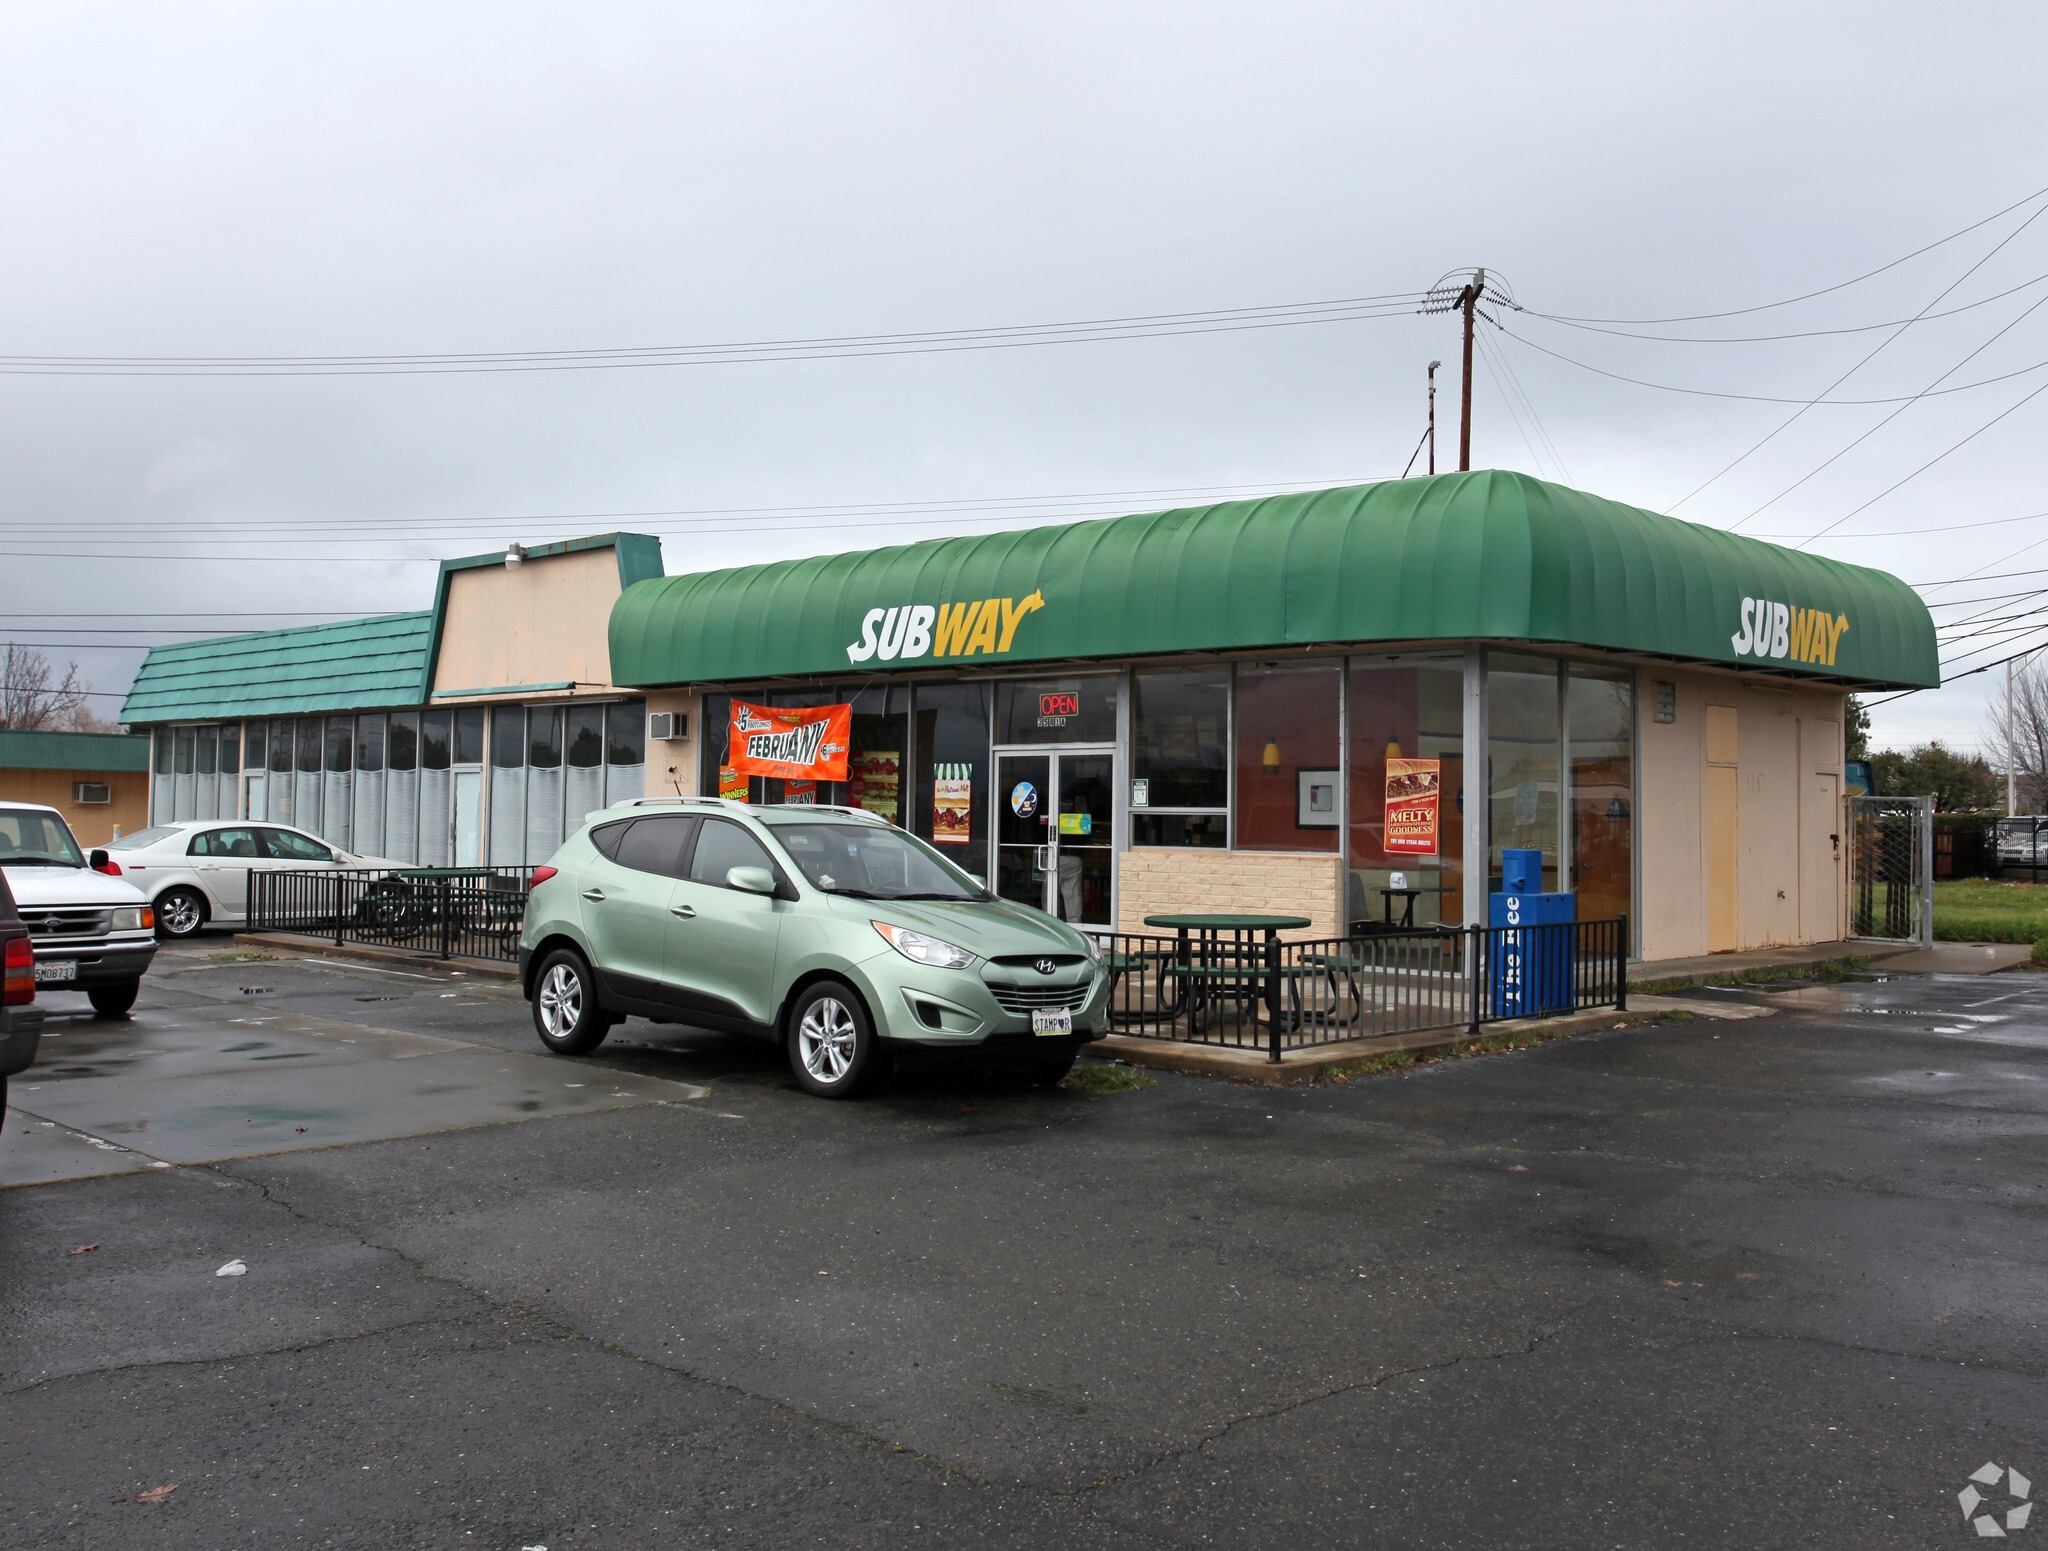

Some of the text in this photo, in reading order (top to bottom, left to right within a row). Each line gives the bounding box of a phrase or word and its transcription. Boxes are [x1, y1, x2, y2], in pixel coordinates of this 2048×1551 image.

[847, 588, 1045, 664] SUBWAY
[1731, 597, 1849, 666] SUBWAY
[1041, 695, 1076, 715] OPEN
[747, 719, 829, 765] FEBRUANY
[720, 787, 749, 799] WINNERS
[1390, 809, 1433, 822] MELTY
